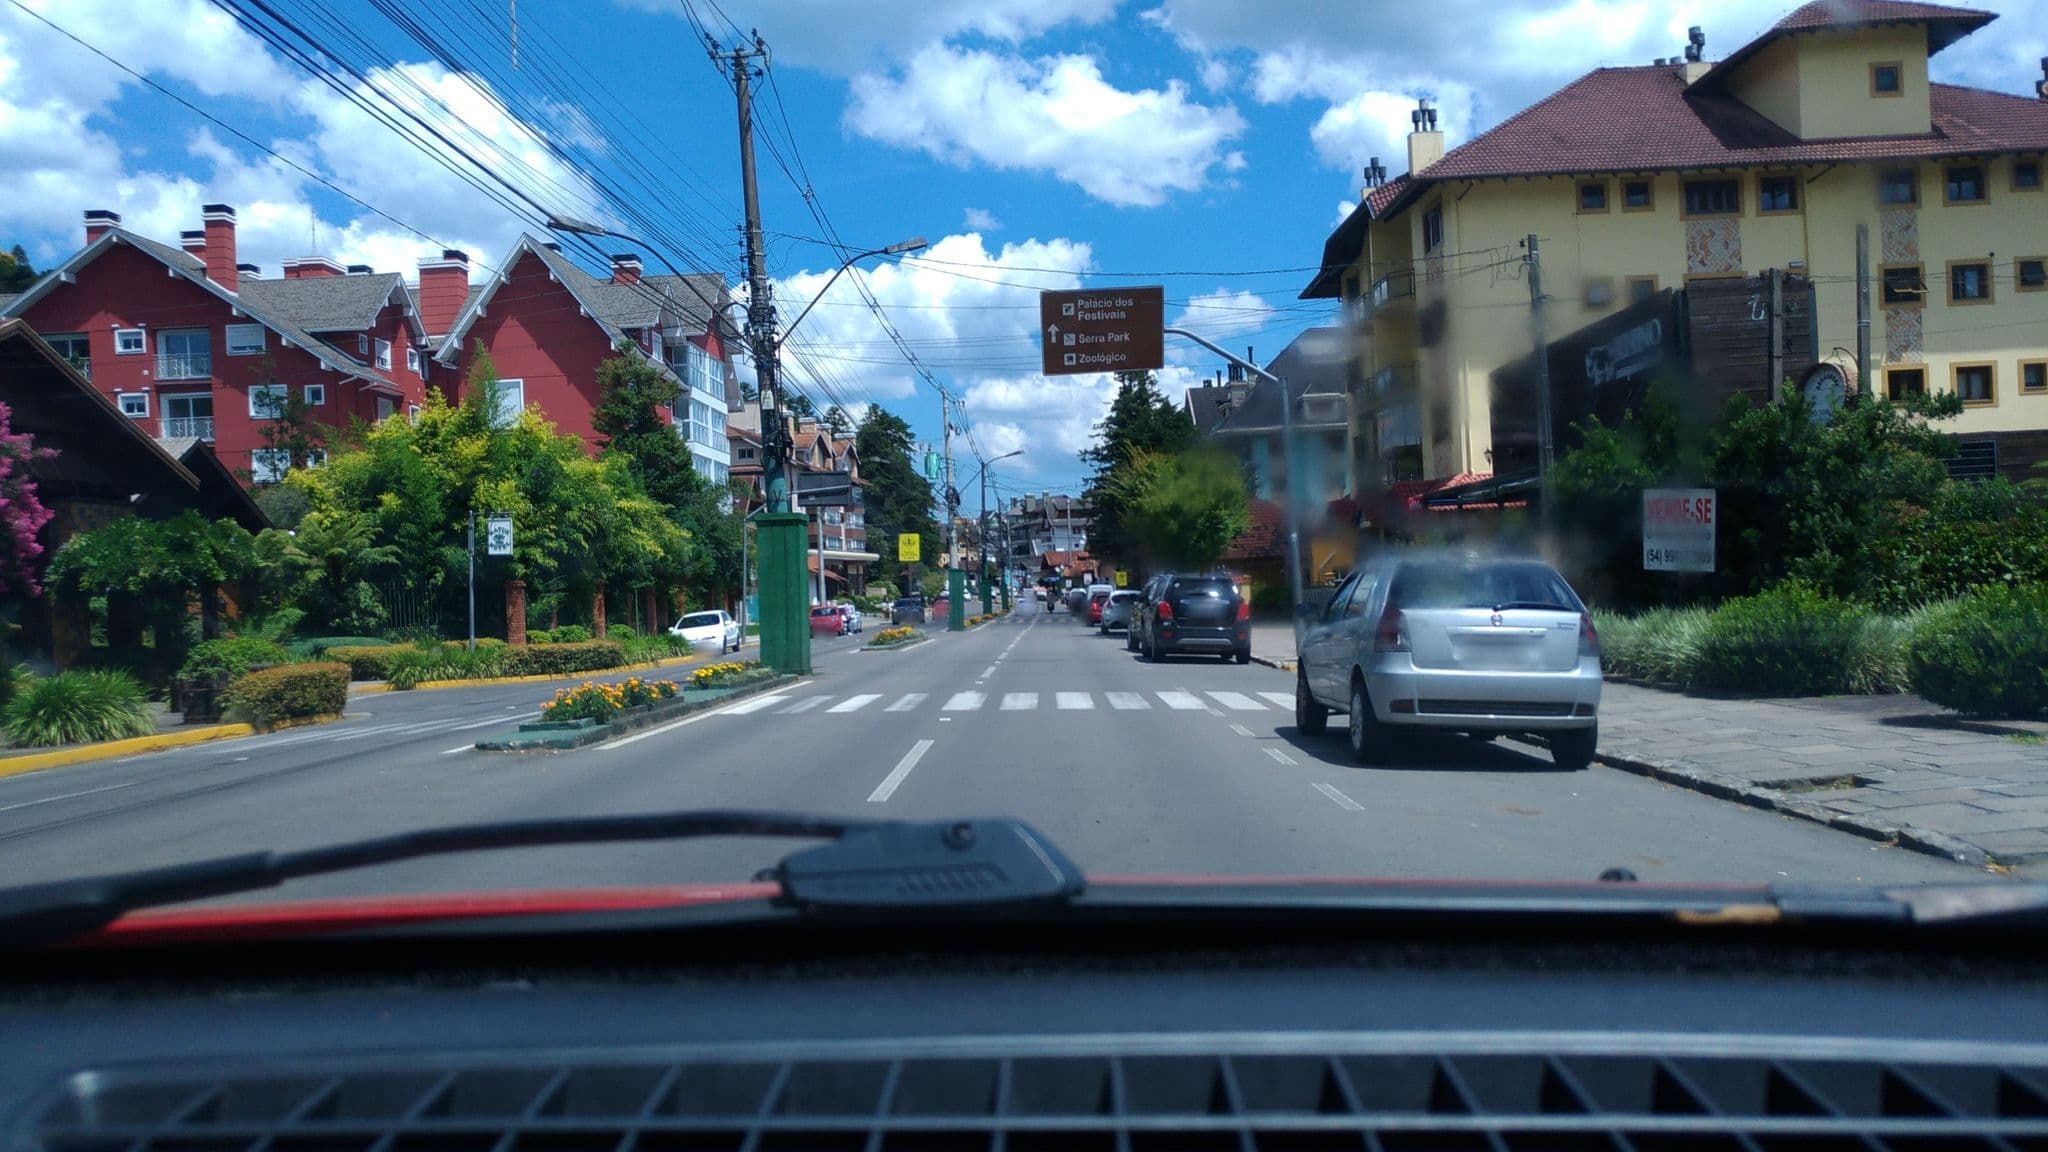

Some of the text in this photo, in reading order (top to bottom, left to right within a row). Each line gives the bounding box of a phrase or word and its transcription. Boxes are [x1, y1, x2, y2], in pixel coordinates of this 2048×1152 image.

[1077, 297, 1134, 309] Palácio dos
[1077, 309, 1127, 321] Festivais
[1078, 332, 1130, 344] Serra Park
[1079, 351, 1127, 365] Zoológico
[1646, 548, 1662, 565] (54)
